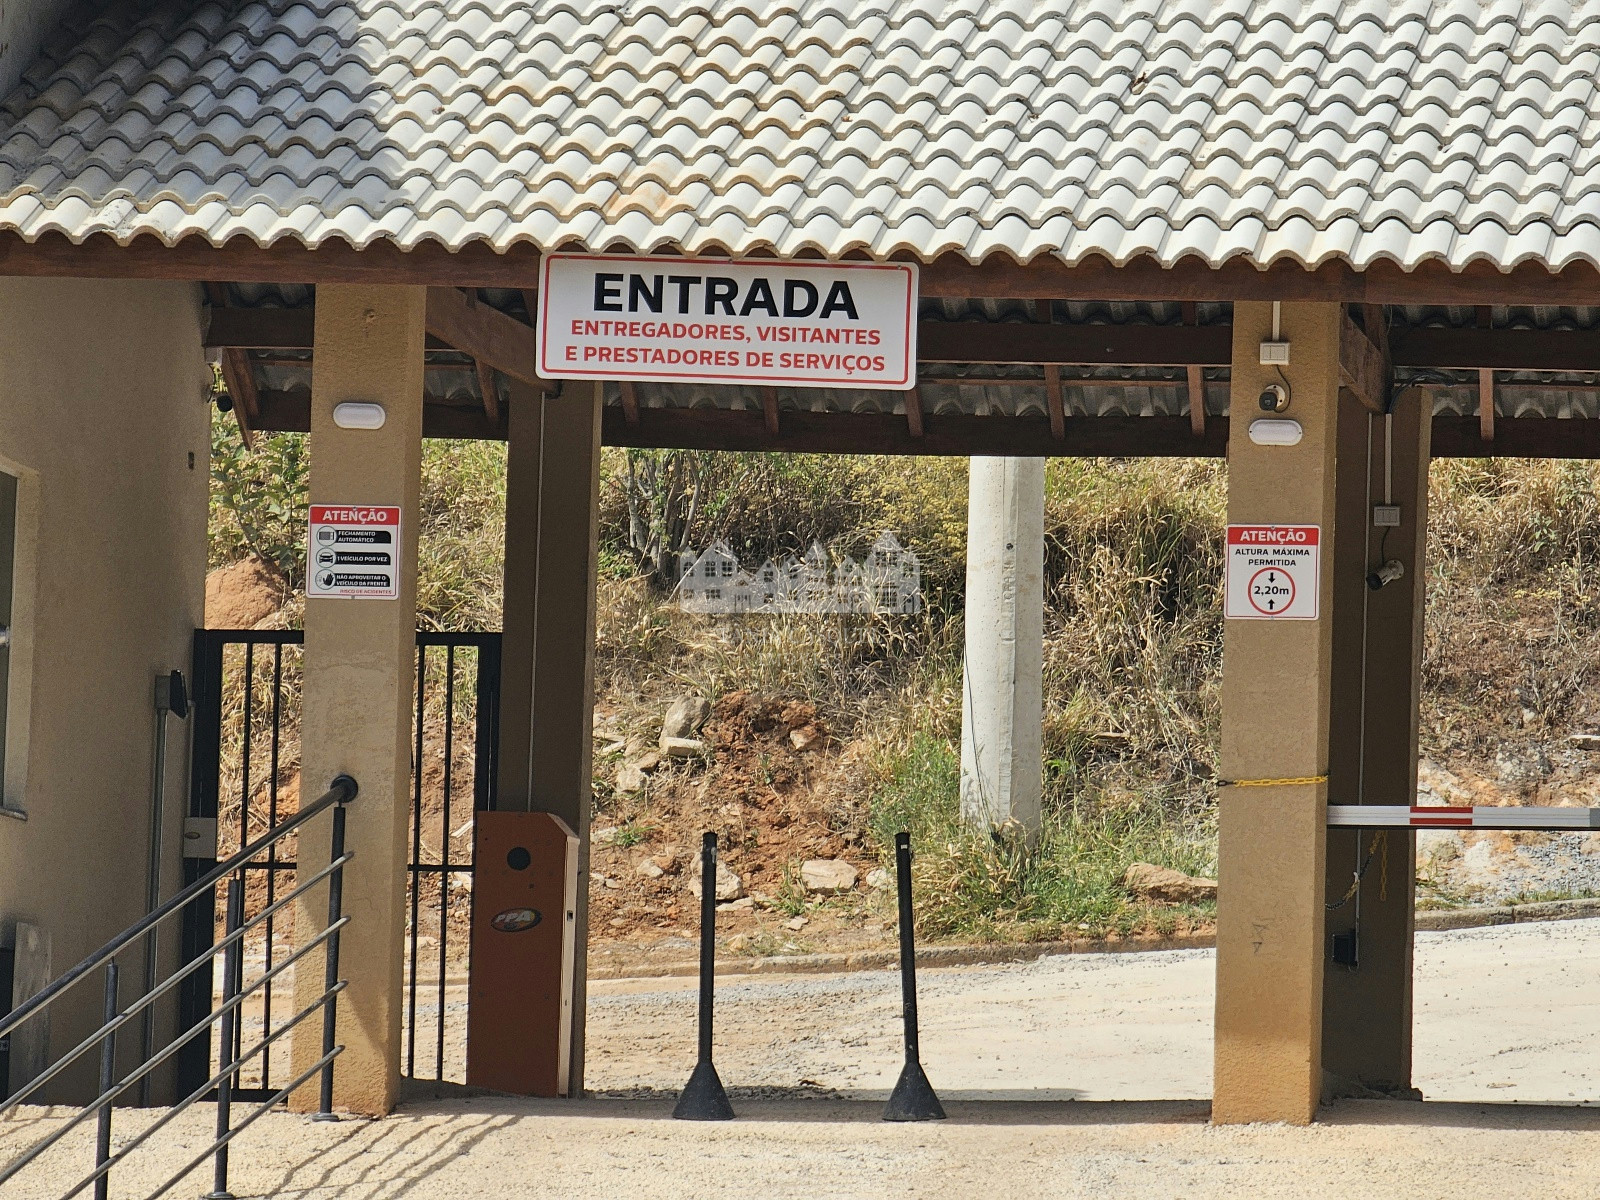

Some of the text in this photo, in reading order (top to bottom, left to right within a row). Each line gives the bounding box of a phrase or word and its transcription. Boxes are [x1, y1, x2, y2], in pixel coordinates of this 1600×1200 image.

[593, 272, 859, 320] ENTRADA
[571, 319, 881, 346] ENTREGADORES, VISITANTES
[565, 346, 886, 375] E PRESTADORES DE SERVIÇOS
[322, 508, 387, 524] ATENÇÃO
[1240, 529, 1306, 544] ATENÇÃO
[1235, 547, 1310, 556] ALTURA MÁXIMA
[1254, 586, 1289, 596] 2,20m
[494, 910, 531, 923] PPA
